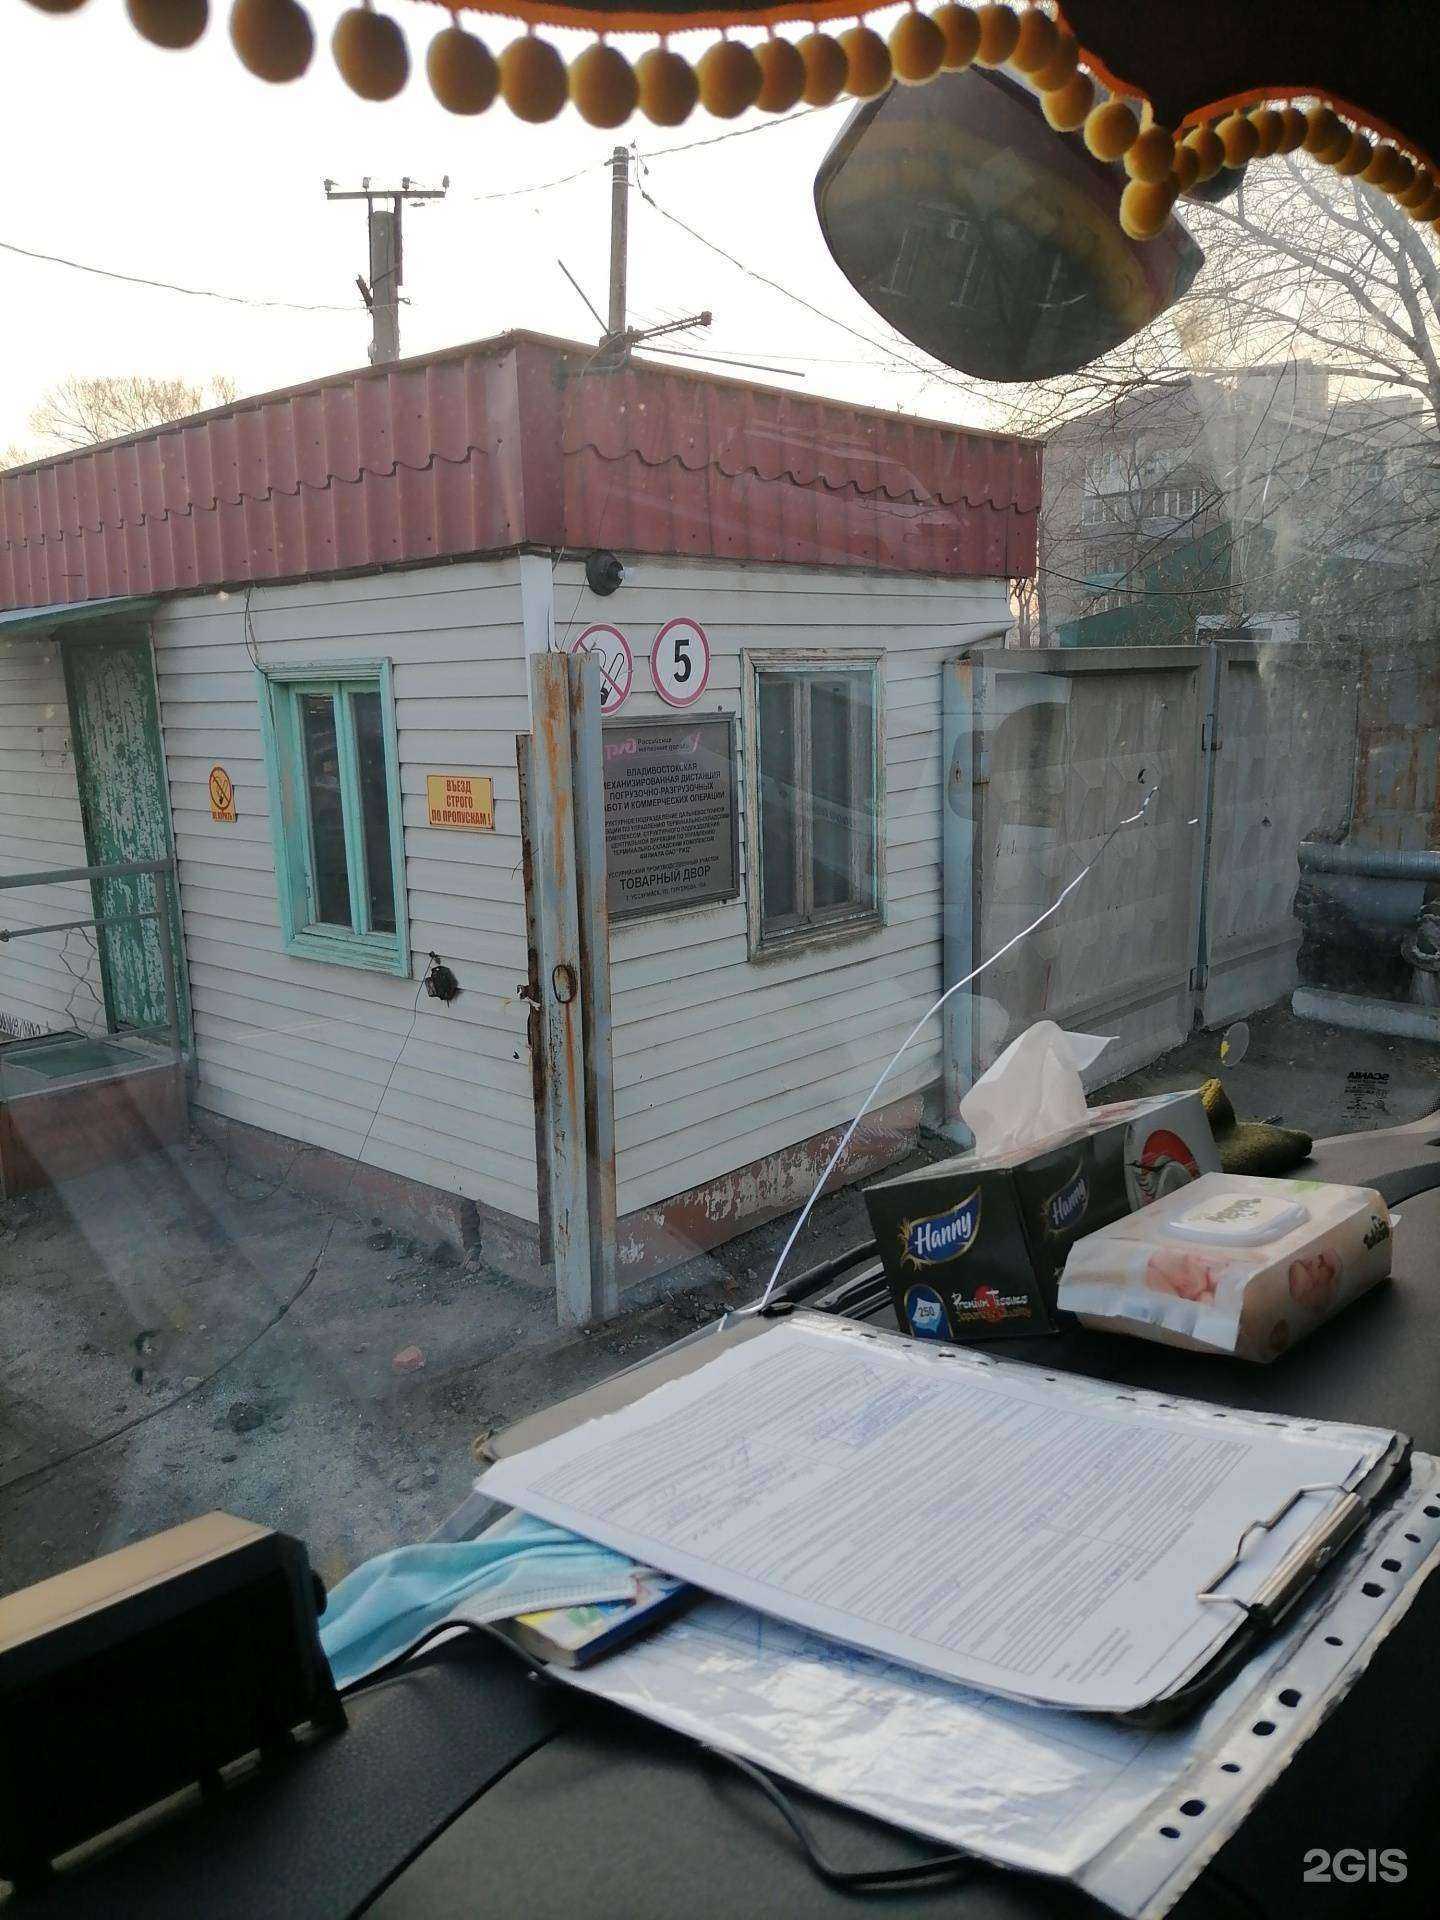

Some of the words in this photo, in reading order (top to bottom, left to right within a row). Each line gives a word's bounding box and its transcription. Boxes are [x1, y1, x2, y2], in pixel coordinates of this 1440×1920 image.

[674, 638, 691, 682] 5
[627, 763, 697, 777] ВЛАДИВОСТОКСКАЯ
[681, 771, 720, 784] ДИСТАНЦИЯ
[446, 779, 472, 794] ВЪЕЗД
[609, 783, 714, 800] ПОГРУЗОЧНО-РАЗГРУЗОЧНЫХ
[446, 795, 473, 808] СТРОГО
[604, 802, 622, 813] БОТ
[623, 801, 630, 810] И
[631, 796, 689, 809] КОММЕРЧЕСКИХ
[431, 809, 441, 822] ПО
[443, 809, 486, 826] ПРОПУСКАМ
[618, 869, 680, 891] ТОВАРНЫЙ
[682, 863, 711, 882] ДВОР
[914, 1211, 972, 1254] Hanny
[917, 1306, 935, 1317] 250
